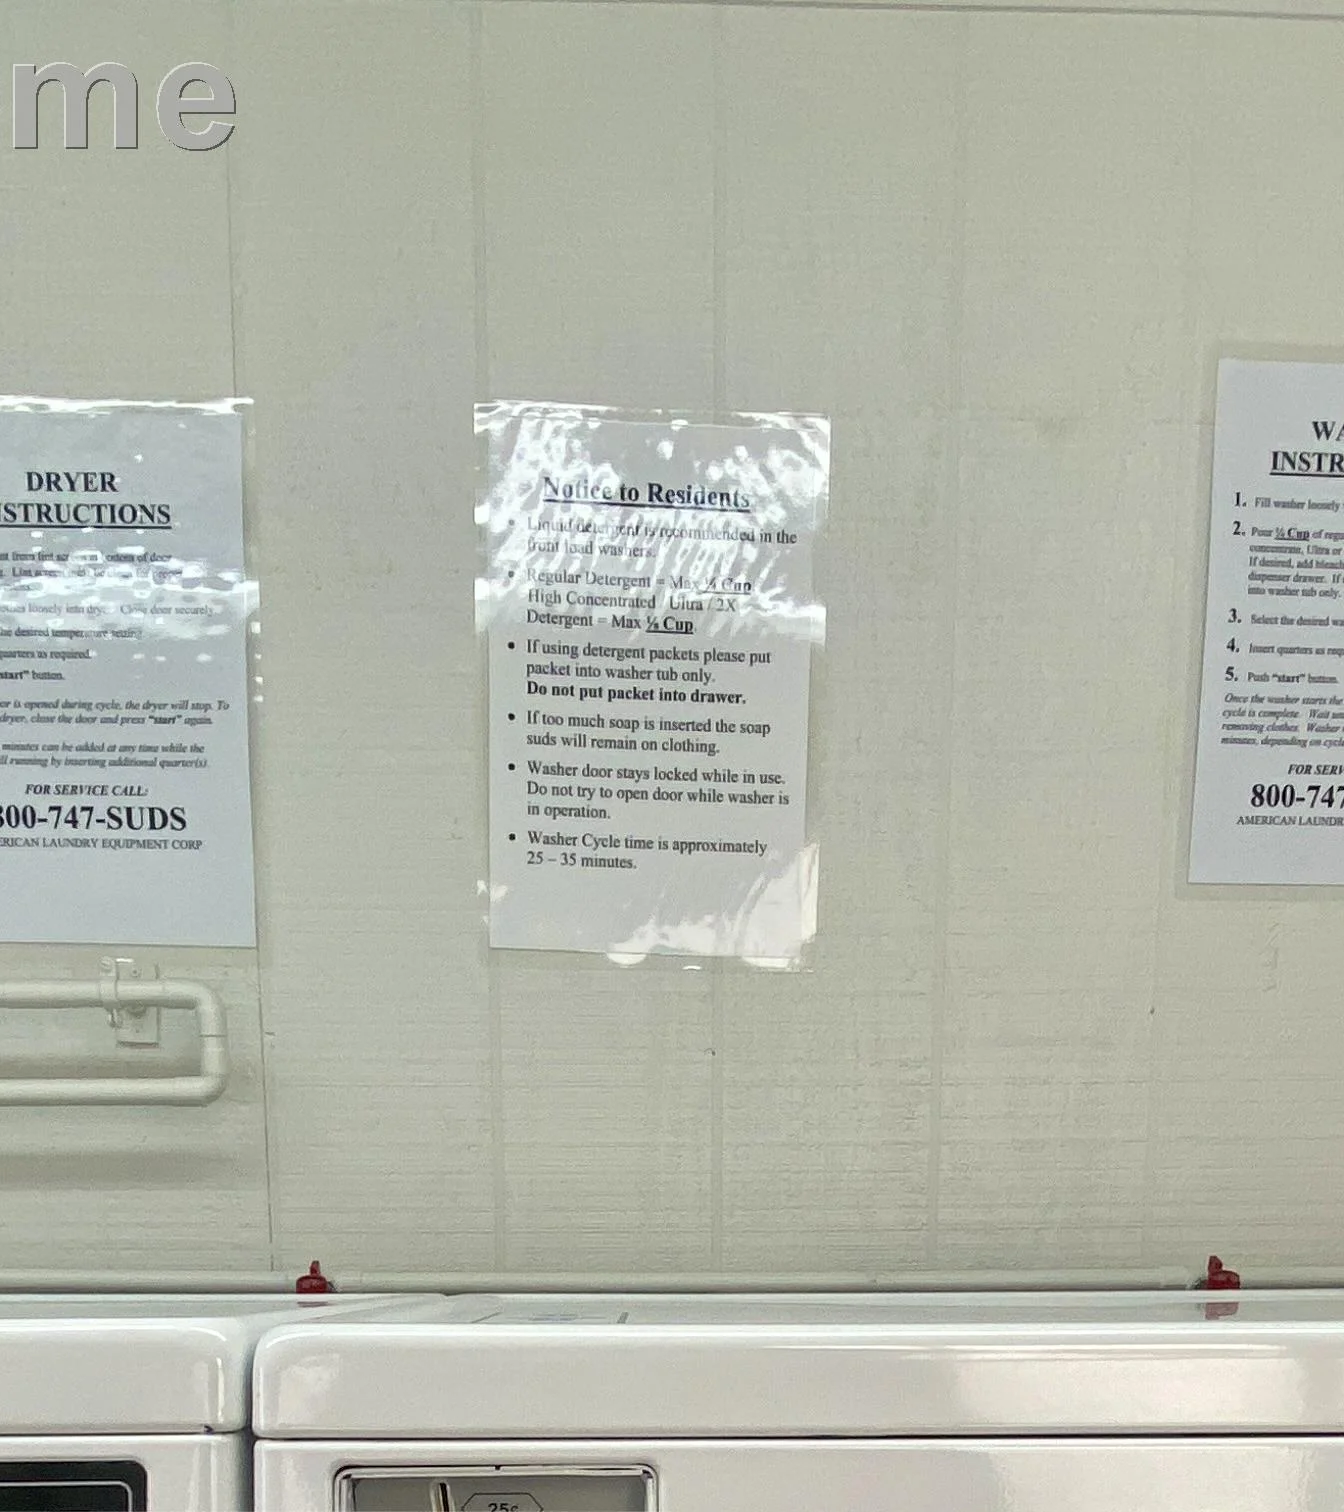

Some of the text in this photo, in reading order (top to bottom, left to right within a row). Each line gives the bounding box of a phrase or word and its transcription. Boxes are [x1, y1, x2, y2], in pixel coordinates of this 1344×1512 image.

[26, 471, 119, 492] DRYER
[619, 482, 639, 502] to
[648, 483, 750, 512] Residents
[527, 681, 746, 703] Do not put packet into drawer.
[527, 710, 770, 736] If too much soap is inserted the soap
[527, 734, 720, 755] suds will remain on clothing.
[527, 761, 785, 784] Washer door stays locked while in use.
[1287, 764, 1312, 775] FOR
[25, 784, 148, 796] FOR SERVICE CALL:
[527, 782, 789, 805] Do not try to open door while washer is
[527, 803, 610, 820] in operation.
[1236, 816, 1296, 826] AMERICAN
[43, 838, 97, 848] LAUNDRY
[102, 839, 168, 849] EQUIPMENT
[172, 840, 202, 849] CORP
[528, 831, 767, 856] Washer Cycle time is approximately
[527, 852, 544, 865] 25
[560, 853, 577, 866] 35
[581, 854, 637, 869] minutes.
